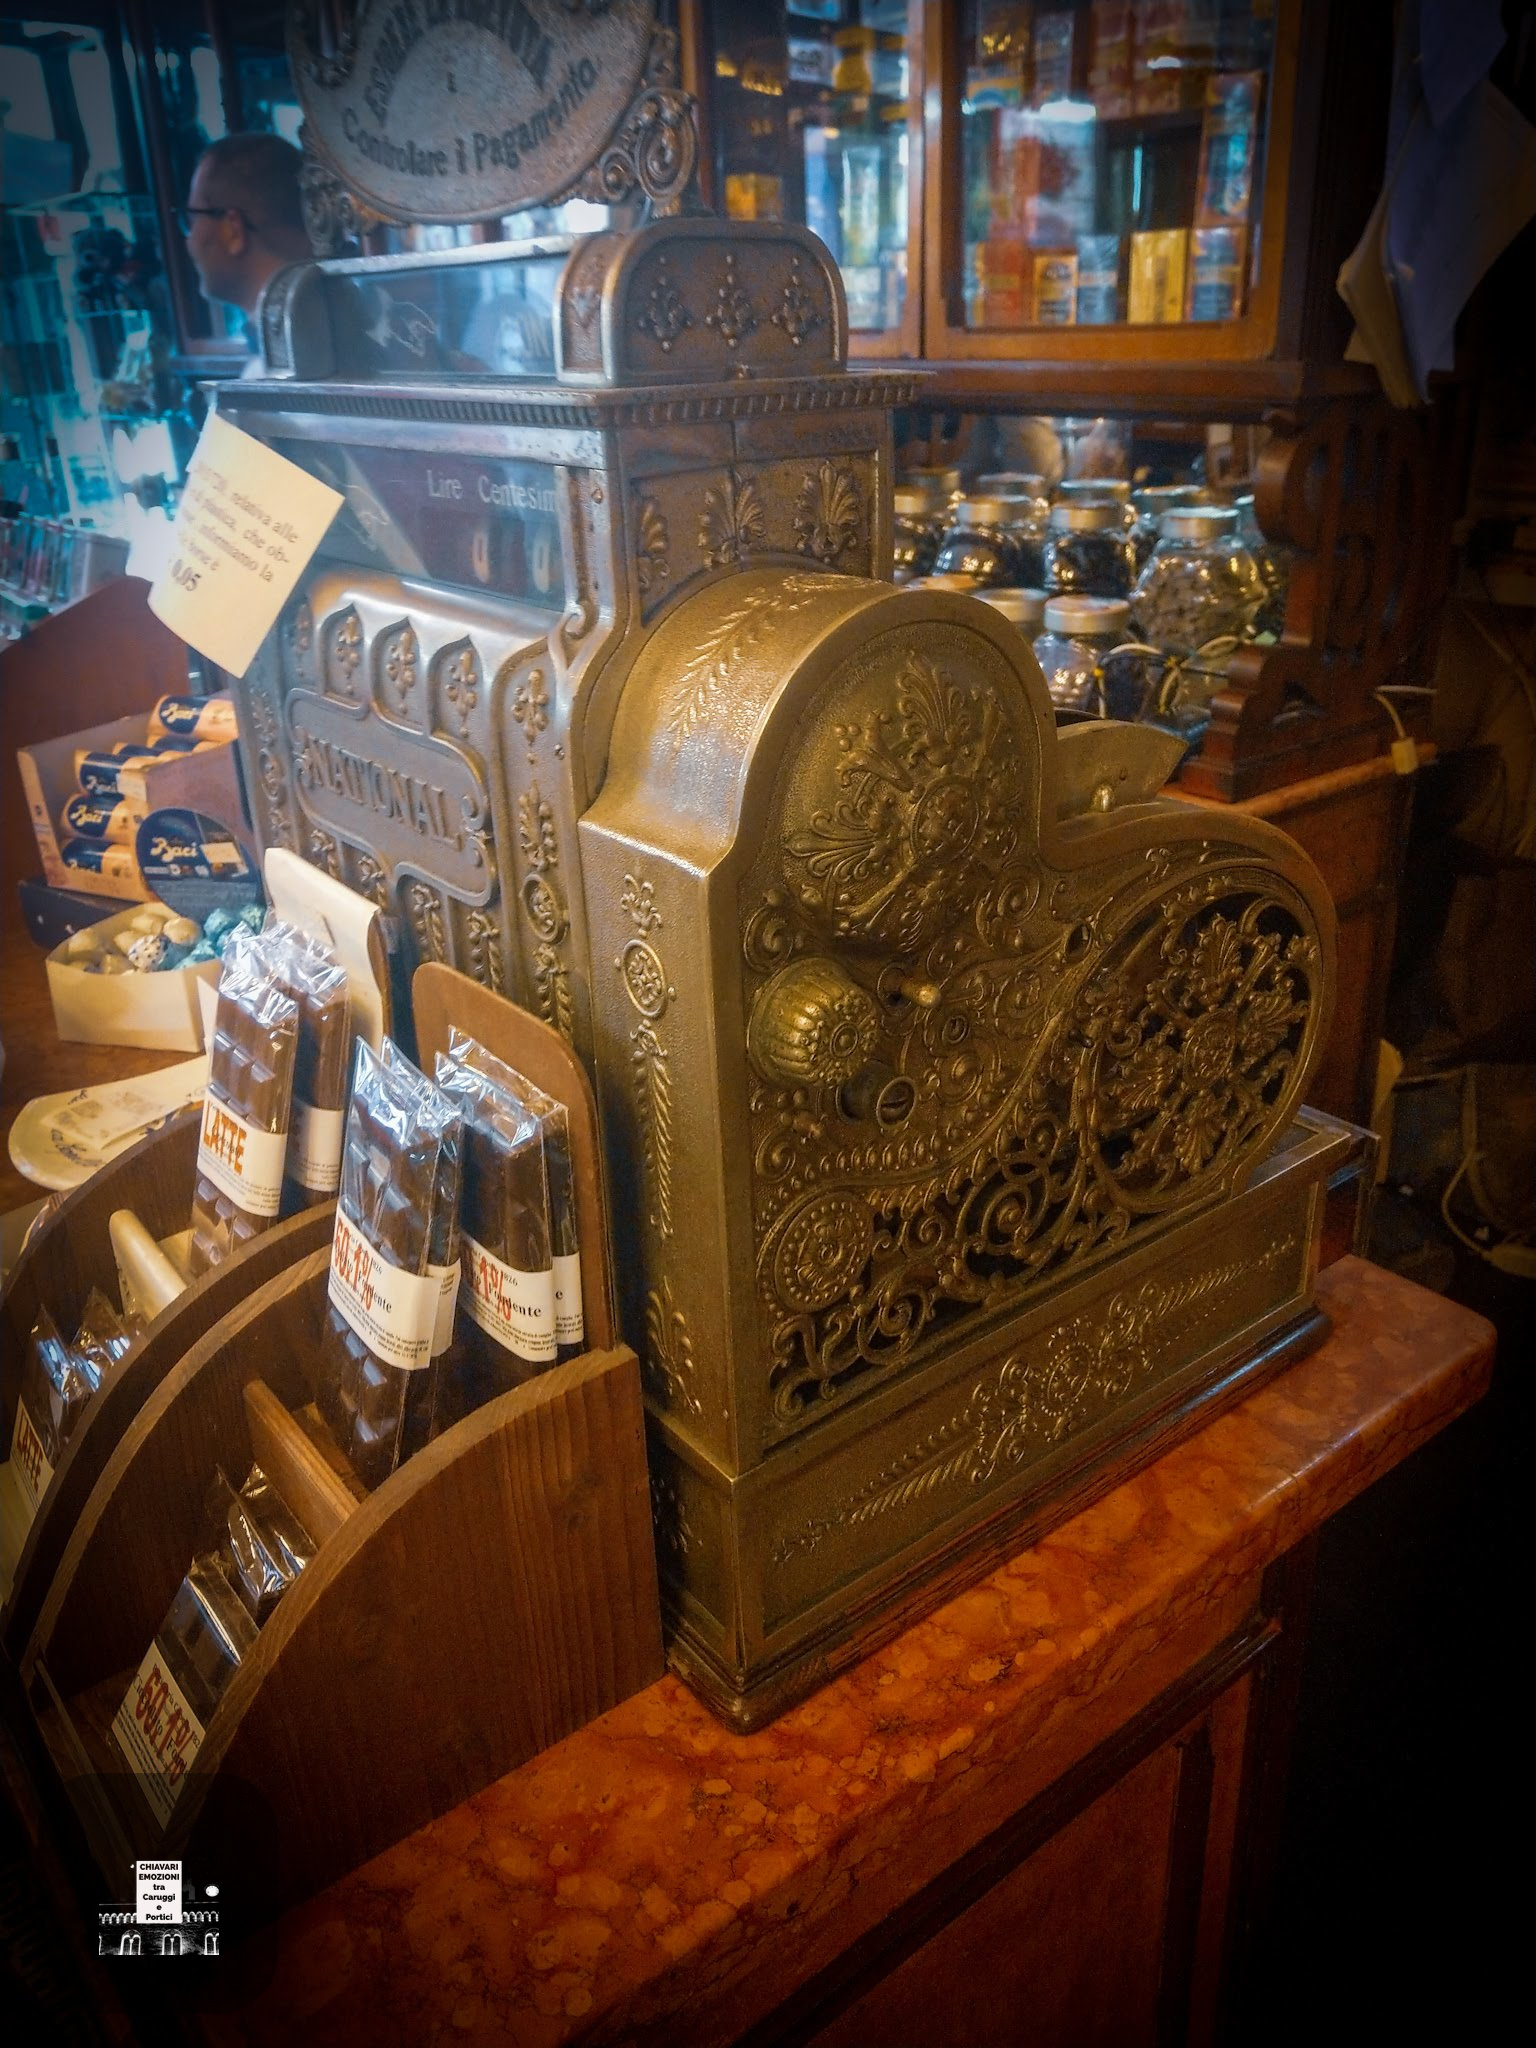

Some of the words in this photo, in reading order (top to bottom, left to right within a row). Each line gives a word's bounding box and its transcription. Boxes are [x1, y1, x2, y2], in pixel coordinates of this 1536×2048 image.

[427, 469, 464, 500] Lire
[272, 522, 298, 543] alle
[259, 563, 273, 583] la
[301, 732, 464, 852] NATIONAL
[150, 837, 198, 862] Baci
[203, 1100, 247, 1176] LATTE
